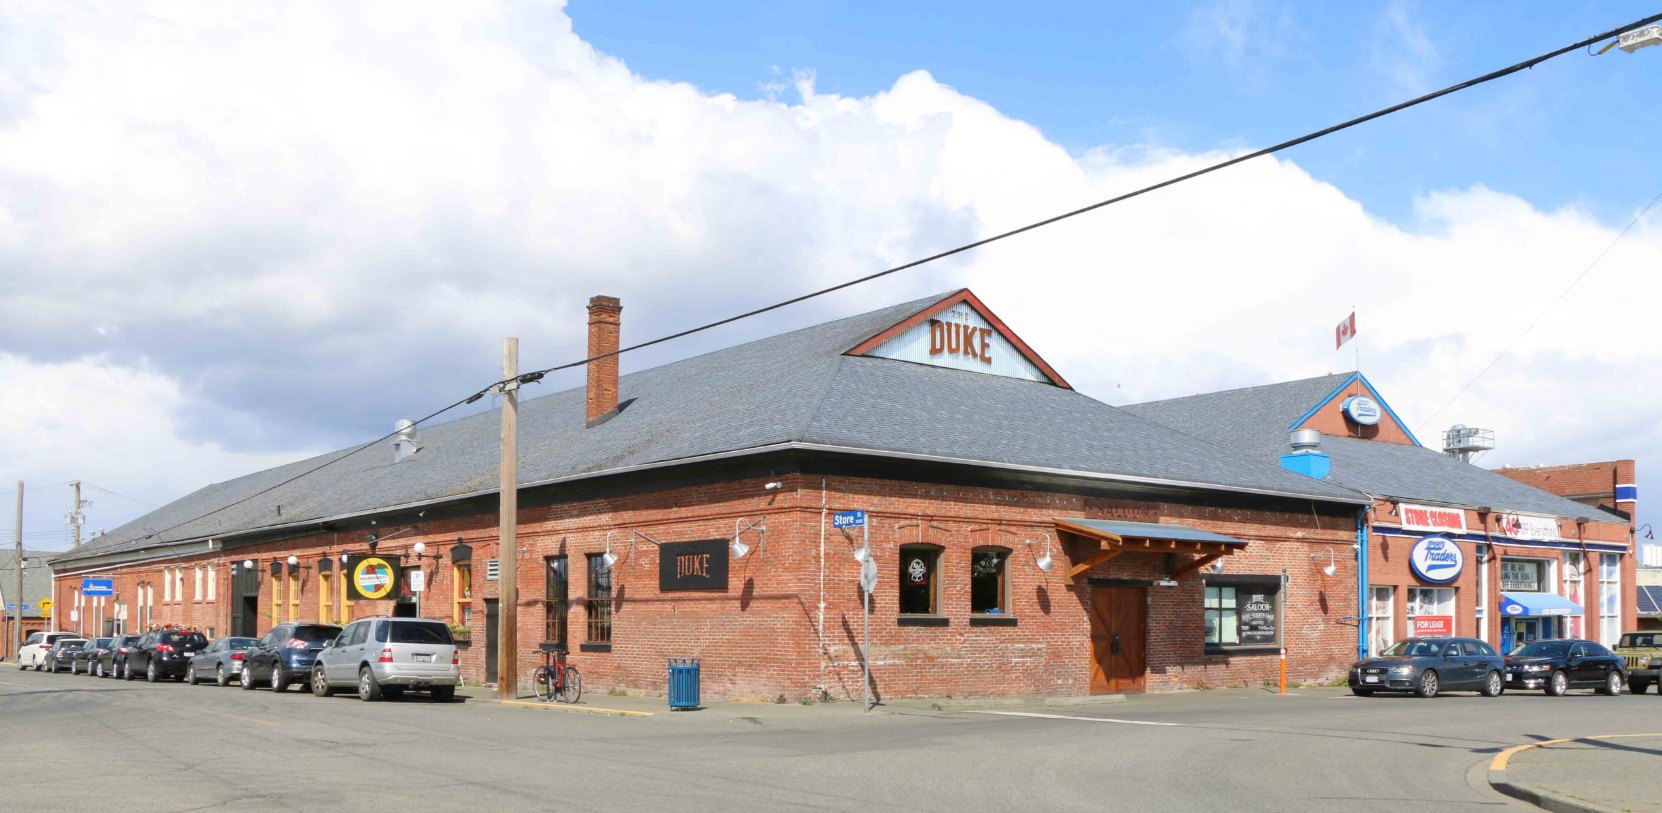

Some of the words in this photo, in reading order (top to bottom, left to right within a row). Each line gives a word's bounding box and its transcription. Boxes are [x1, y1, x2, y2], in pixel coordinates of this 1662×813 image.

[951, 310, 970, 321] THE
[929, 319, 992, 365] DUKE
[834, 515, 854, 526] Store
[1404, 507, 1430, 527] STORE
[1429, 511, 1463, 529] CLOSING
[1427, 540, 1446, 548] SPORTS
[1424, 547, 1457, 562] Traders
[677, 553, 710, 579] DUKE
[1246, 605, 1270, 613] SALOON
[1416, 620, 1429, 629] FOR
[1429, 620, 1444, 629] LEASE
